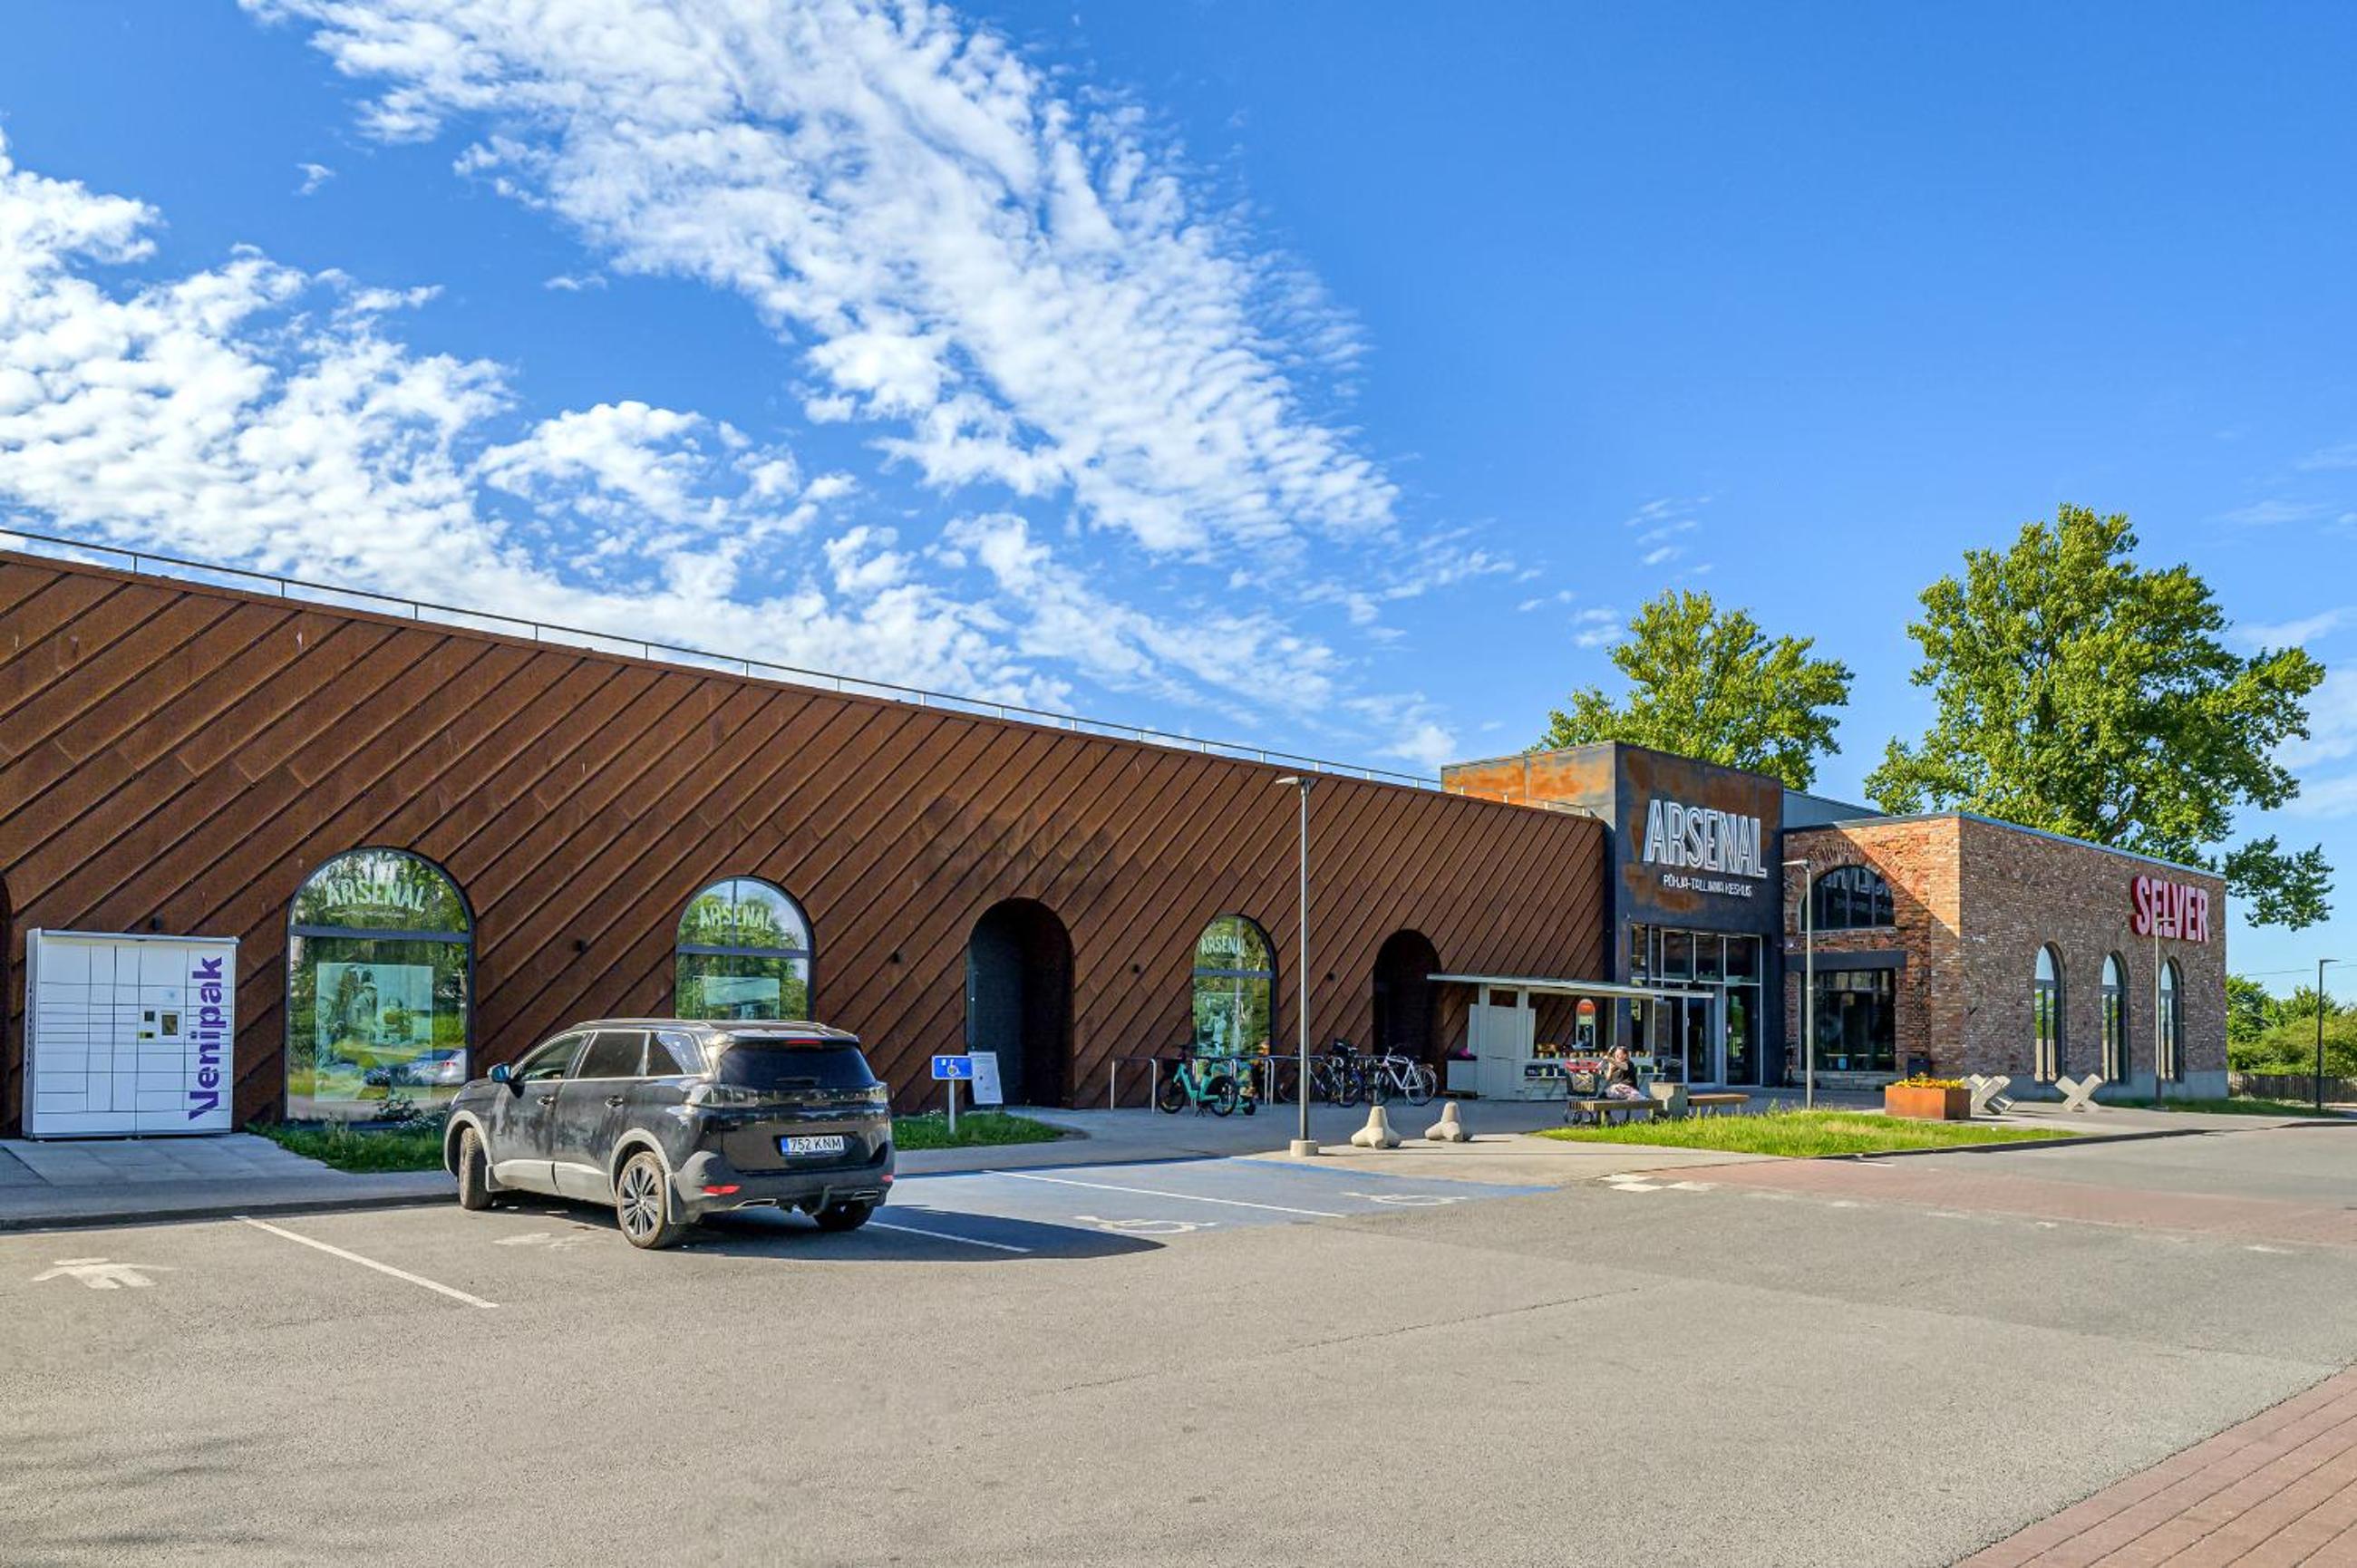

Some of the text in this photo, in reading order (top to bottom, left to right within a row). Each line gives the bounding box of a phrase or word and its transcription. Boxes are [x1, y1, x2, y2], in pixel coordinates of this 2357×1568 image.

[1644, 799, 1767, 878] ARSENAL
[325, 877, 425, 914] ARSENAL
[700, 904, 773, 933] ARSENAL
[2131, 876, 2209, 944] SELVER
[188, 956, 228, 1121] Venipak
[789, 1137, 842, 1150] 752 KNM
